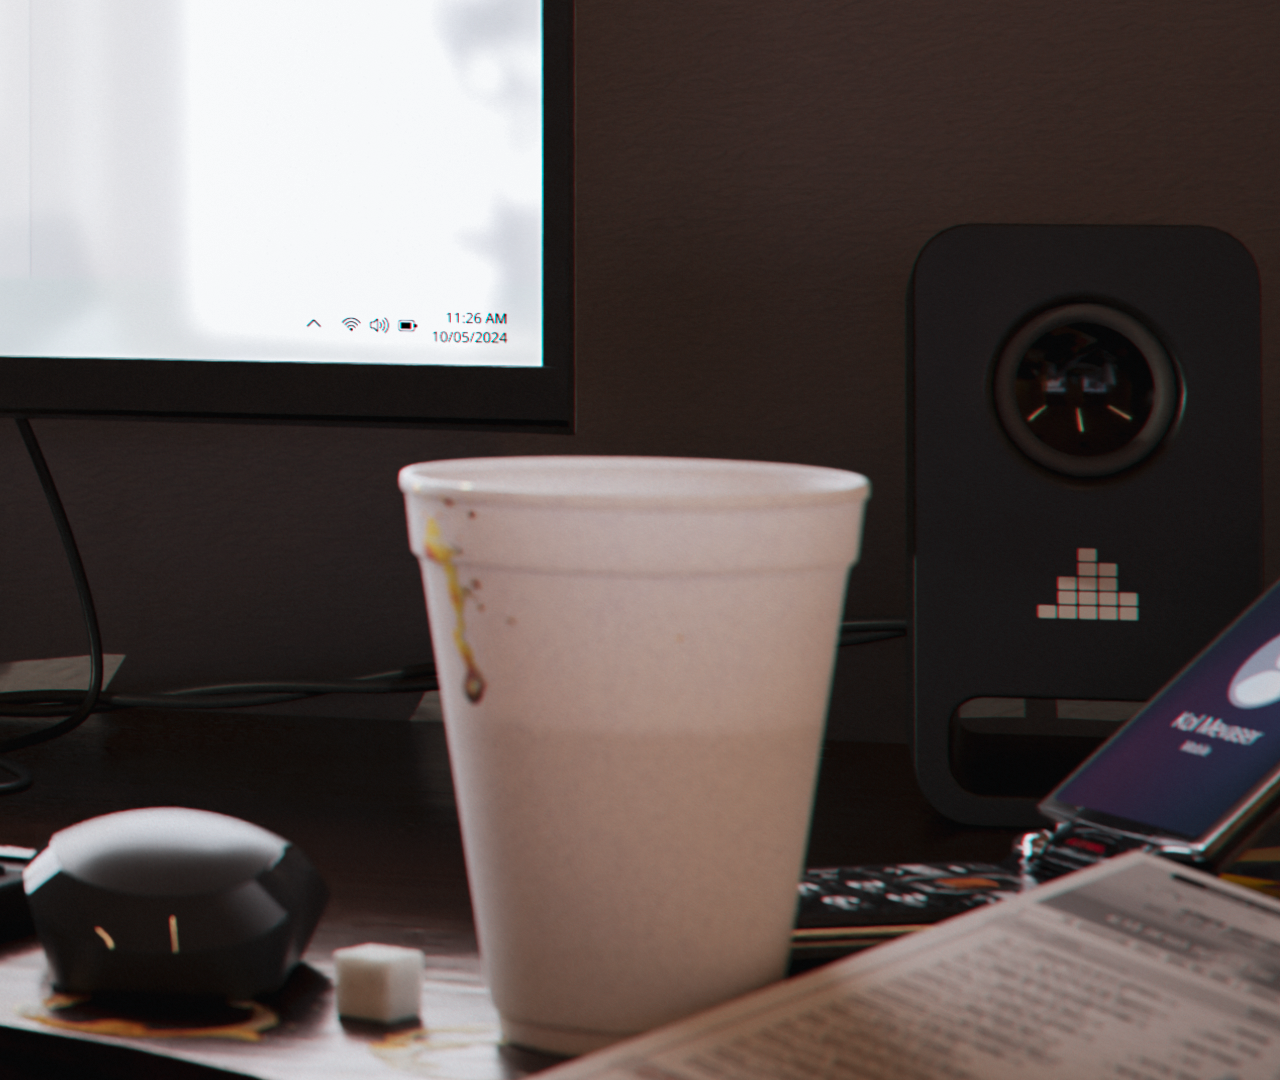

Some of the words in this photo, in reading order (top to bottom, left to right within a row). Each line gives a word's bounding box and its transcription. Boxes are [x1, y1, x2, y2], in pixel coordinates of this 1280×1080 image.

[446, 312, 482, 325] 11:26
[485, 312, 508, 325] AM
[432, 331, 508, 344] 10/05/2024
